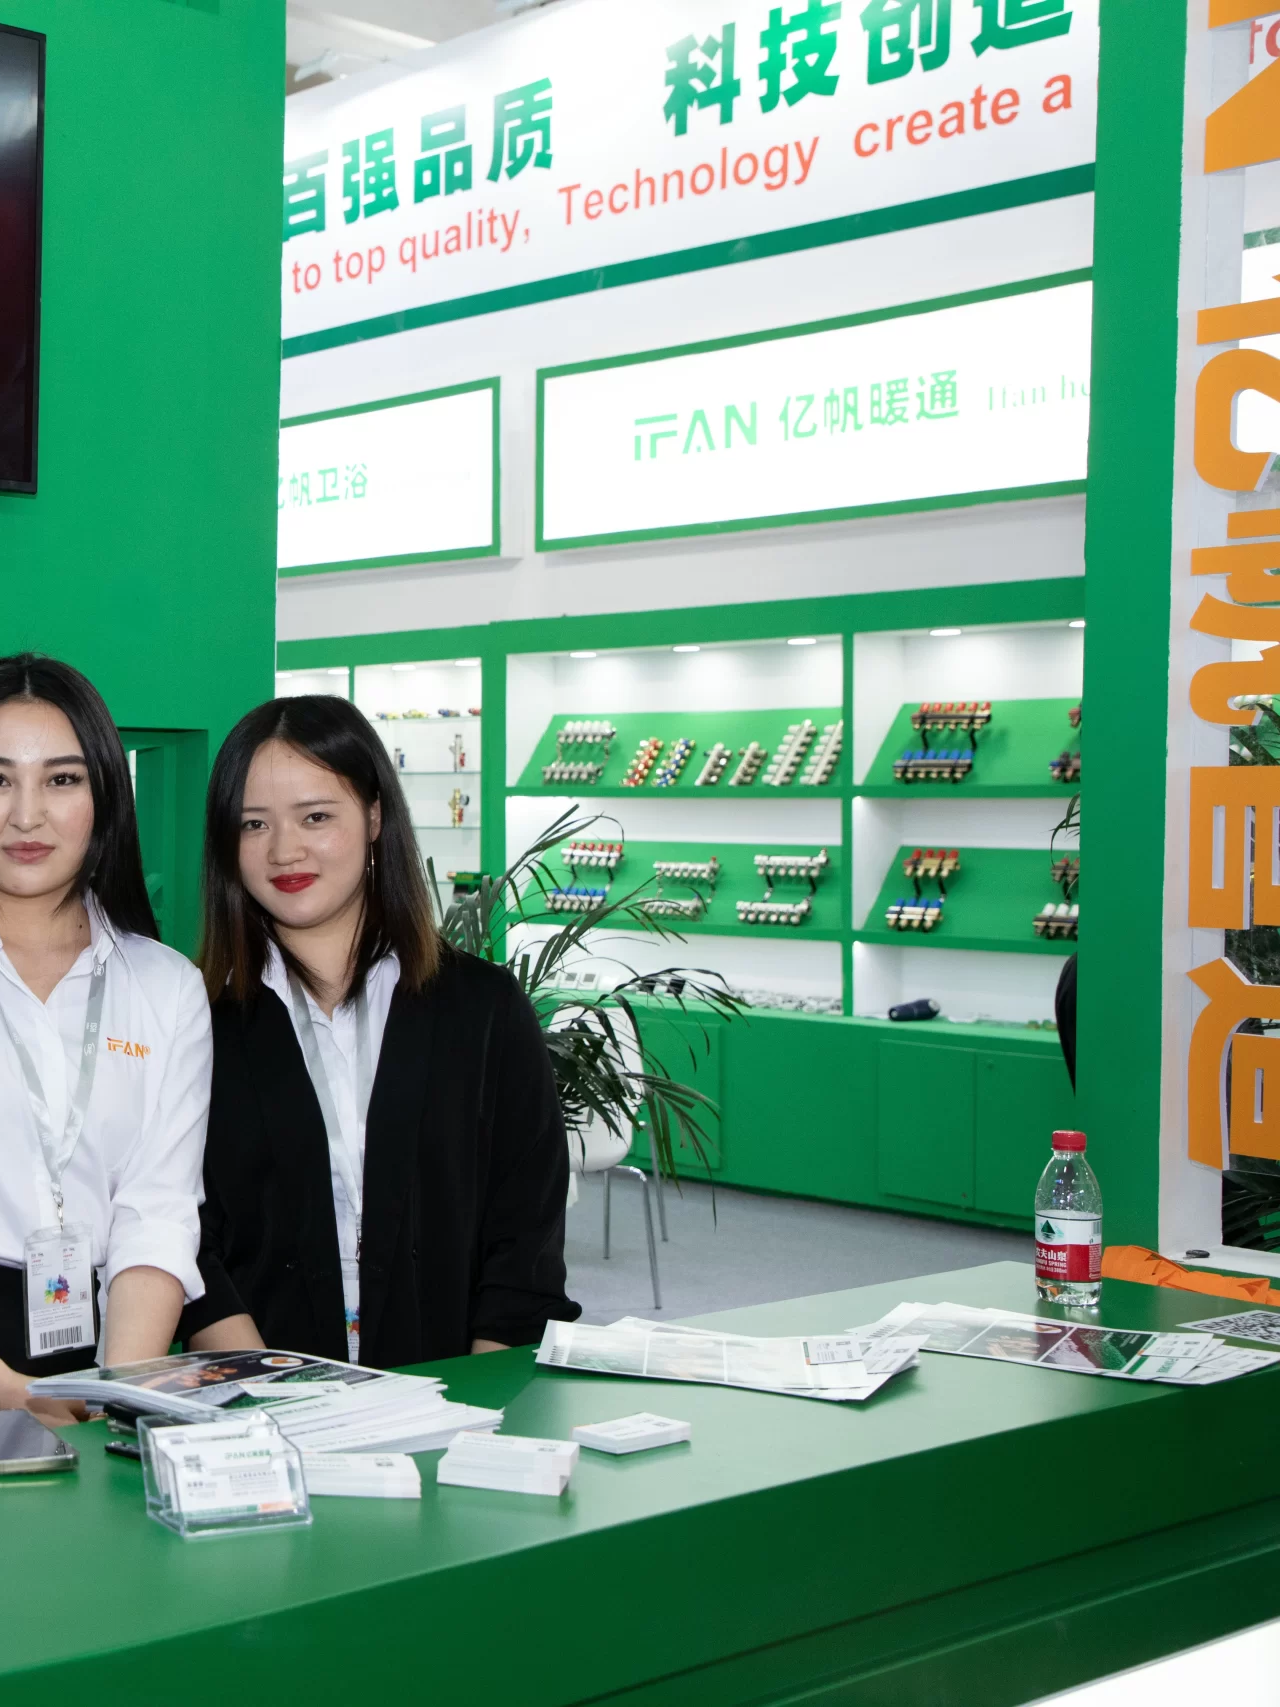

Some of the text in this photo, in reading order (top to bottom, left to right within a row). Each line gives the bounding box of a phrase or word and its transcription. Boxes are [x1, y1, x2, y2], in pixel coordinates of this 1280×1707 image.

[292, 73, 1073, 293] to top quality, Technology create a
[778, 369, 959, 441] 亿帆暖通
